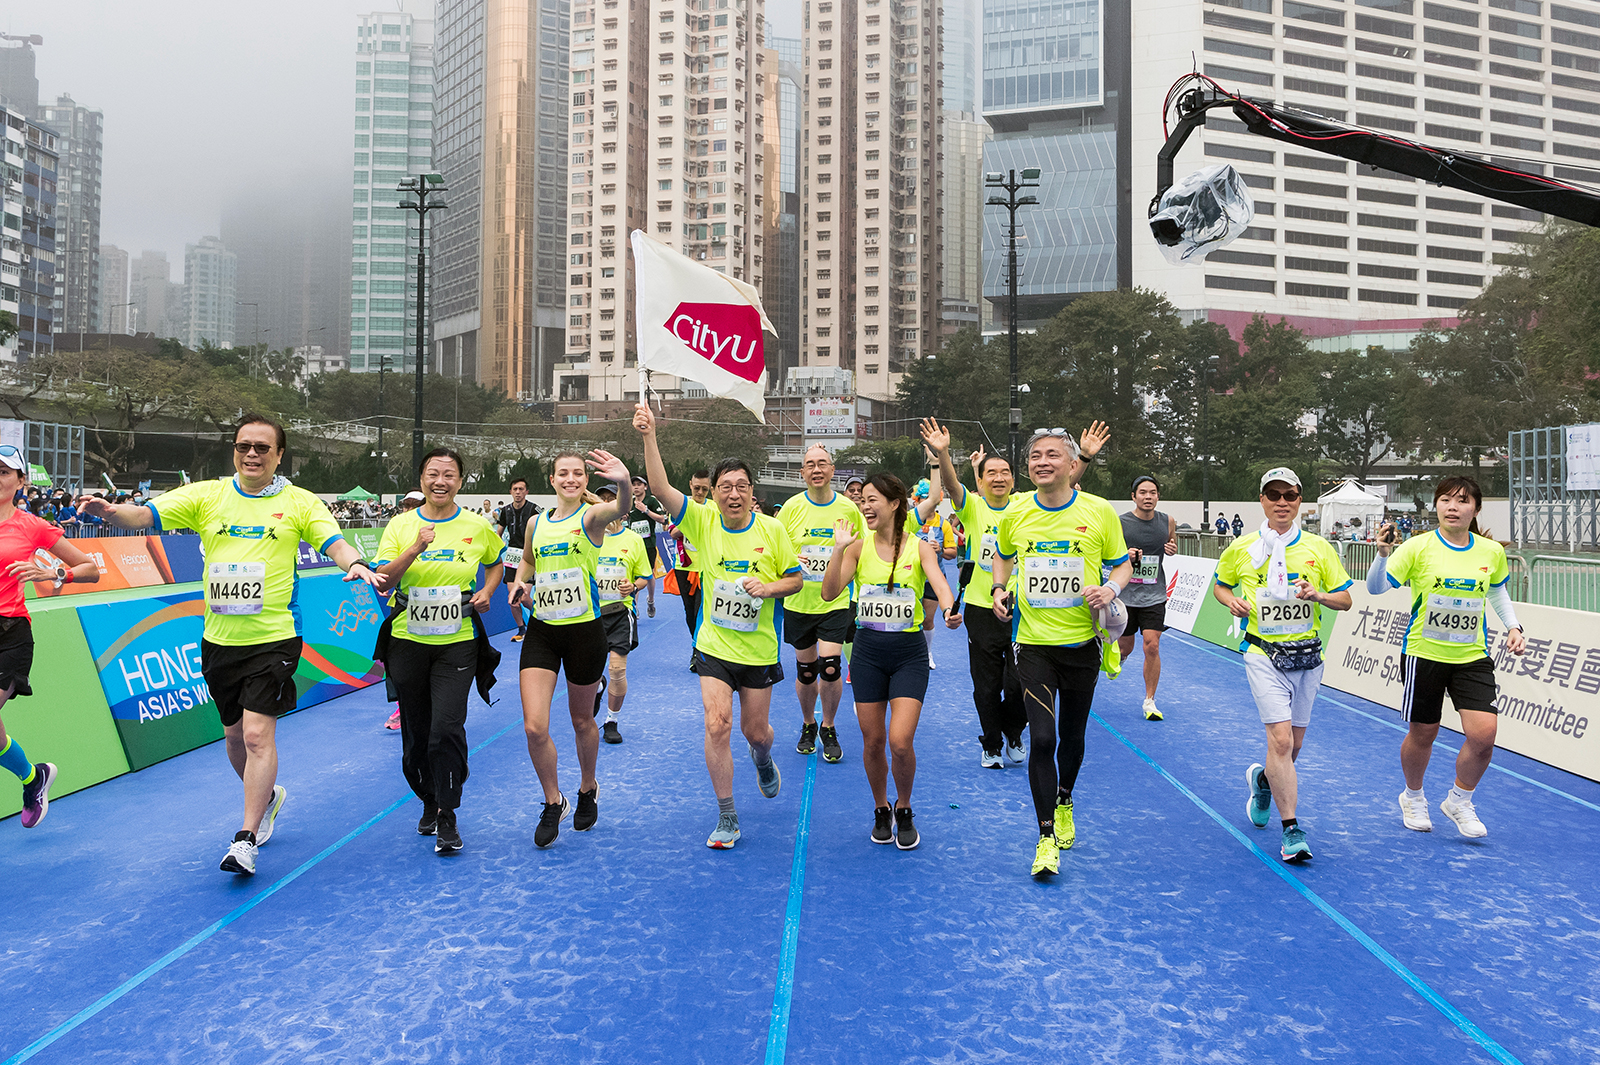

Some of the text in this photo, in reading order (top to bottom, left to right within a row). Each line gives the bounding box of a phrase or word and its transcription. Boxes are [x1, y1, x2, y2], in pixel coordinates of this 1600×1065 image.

[673, 314, 757, 363] CityU
[120, 553, 150, 565] Hexicon
[806, 559, 831, 572] 23
[210, 582, 262, 600] M4462
[596, 579, 621, 591] 470
[1029, 576, 1080, 593] P2076
[538, 586, 582, 608] K4731
[410, 604, 459, 621] K4700
[715, 597, 758, 619] P1239
[861, 602, 913, 618] M5016
[1261, 603, 1311, 621] P2620
[1428, 611, 1478, 630] K4939
[118, 642, 203, 696] HONG
[1342, 646, 1379, 677] Major
[138, 688, 193, 724] ASIA'S
